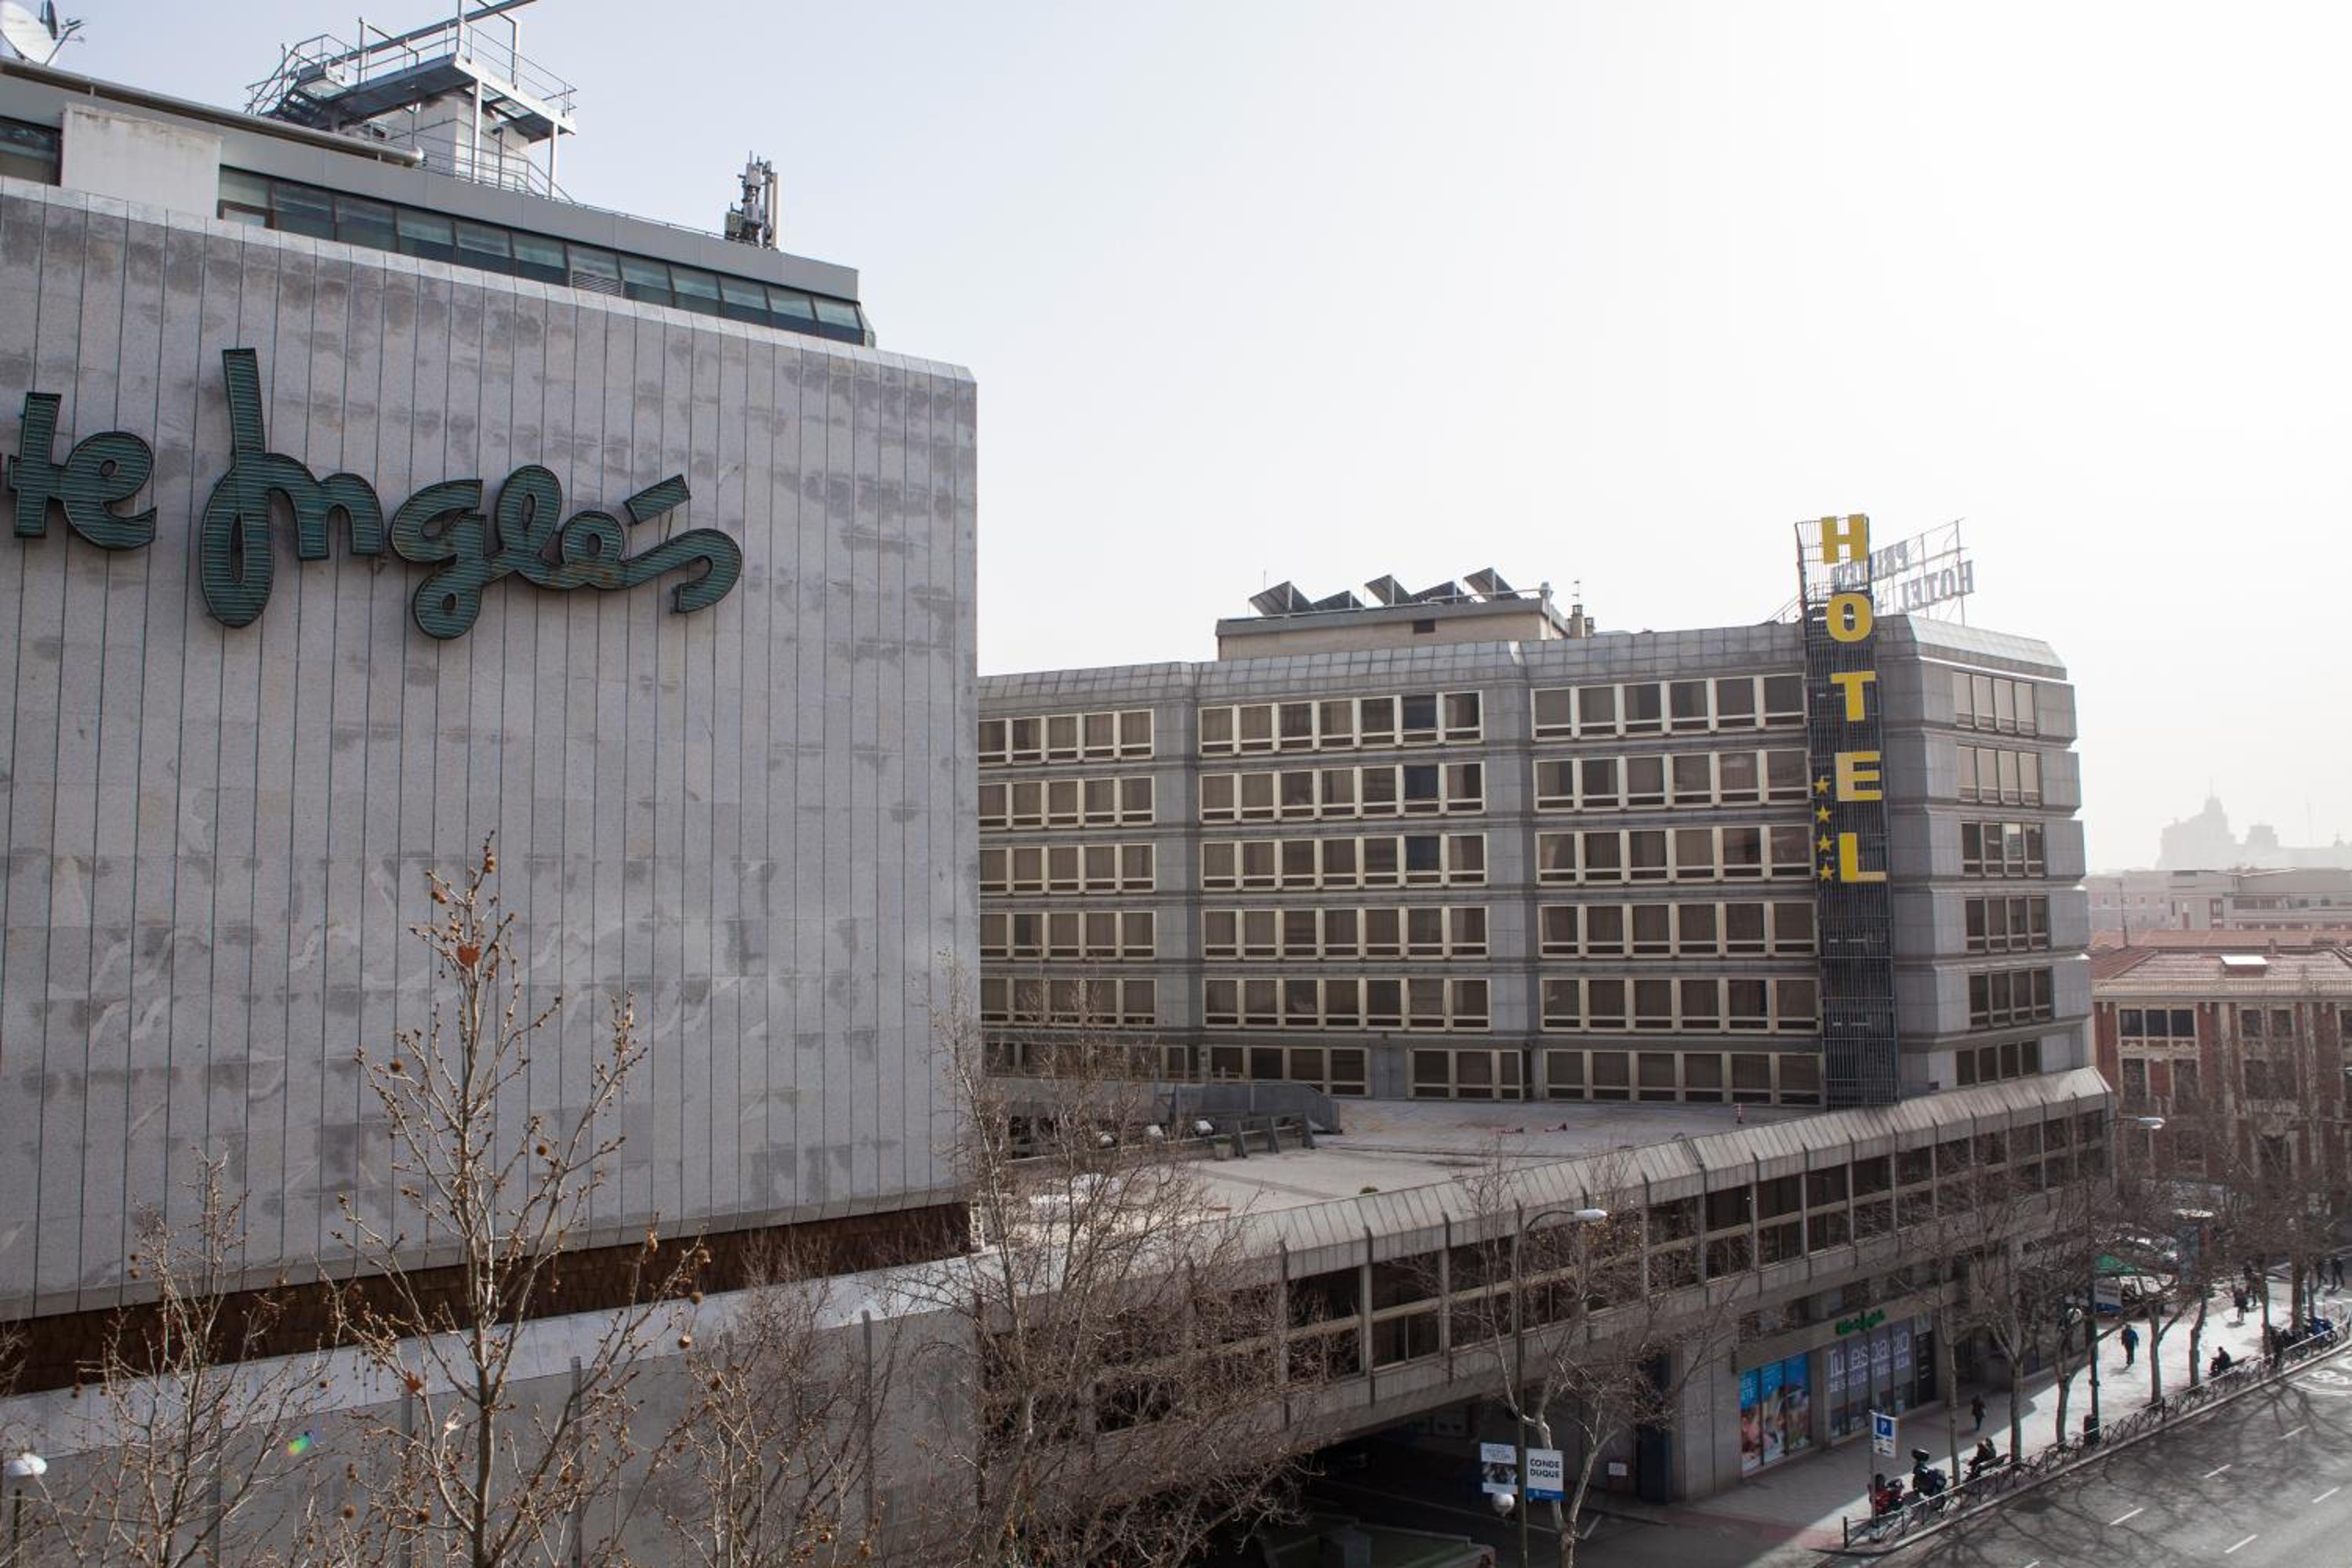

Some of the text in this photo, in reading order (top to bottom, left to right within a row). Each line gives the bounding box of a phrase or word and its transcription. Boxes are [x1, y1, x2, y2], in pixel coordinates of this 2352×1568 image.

[0, 391, 158, 551] te
[1820, 513, 1887, 884] HOTEL
[1530, 1458, 1560, 1468] CONDE
[1530, 1468, 1560, 1479] DUQUE
